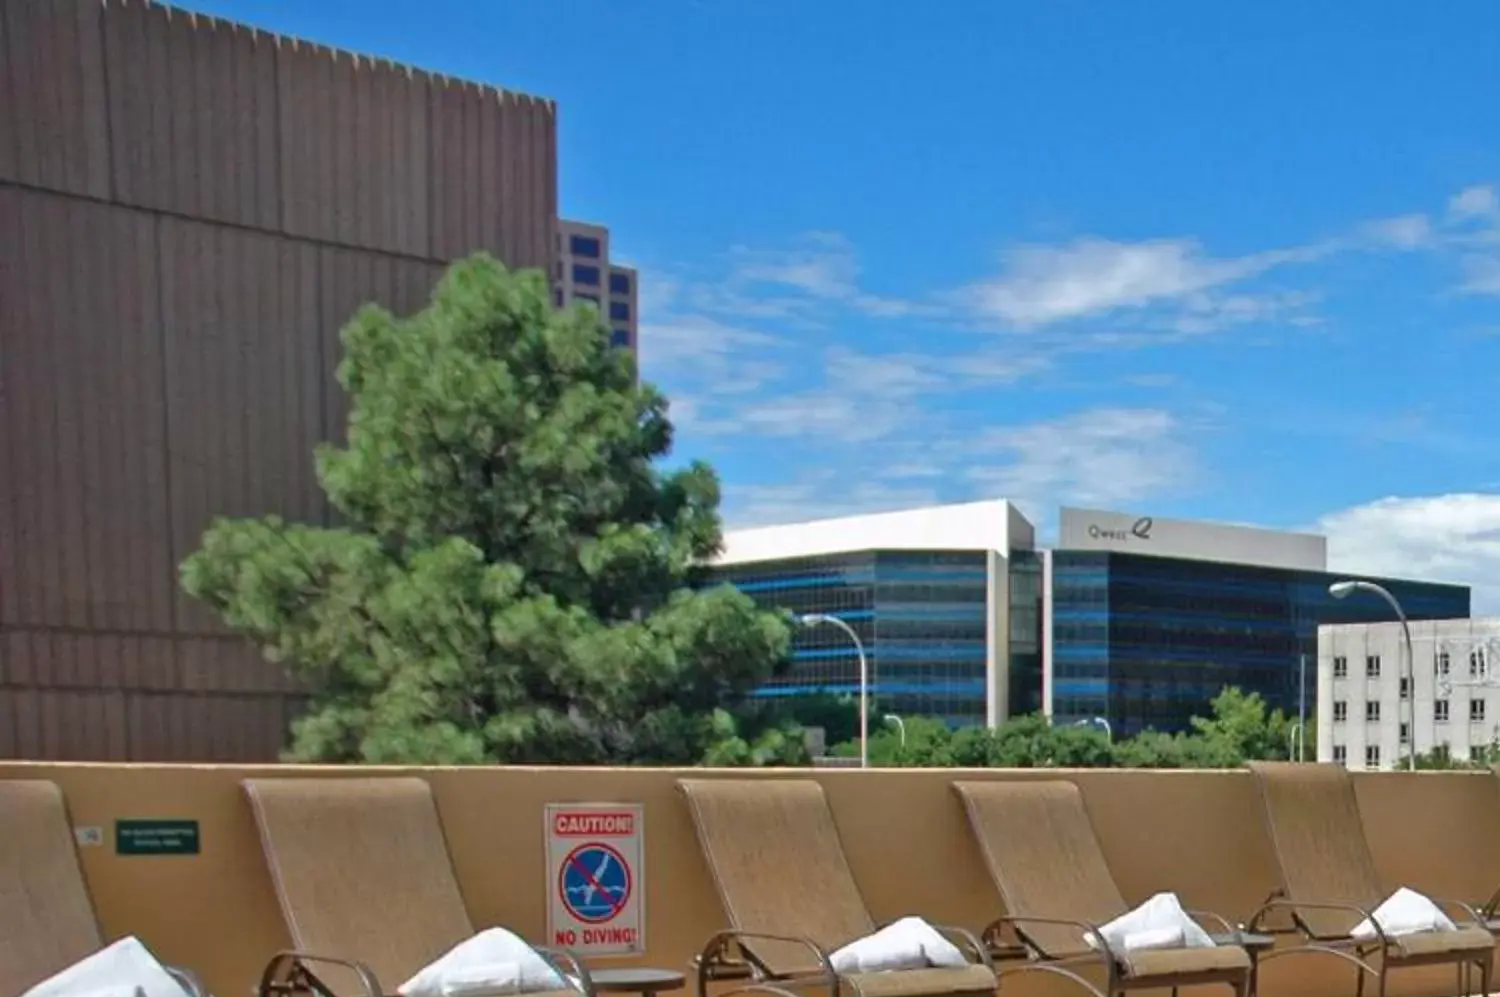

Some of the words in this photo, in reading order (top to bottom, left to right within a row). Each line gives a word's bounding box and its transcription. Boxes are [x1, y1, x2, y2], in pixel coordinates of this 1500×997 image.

[558, 816, 634, 833] CAUTION!
[556, 930, 576, 946] NO
[583, 928, 637, 945] DIVING!
